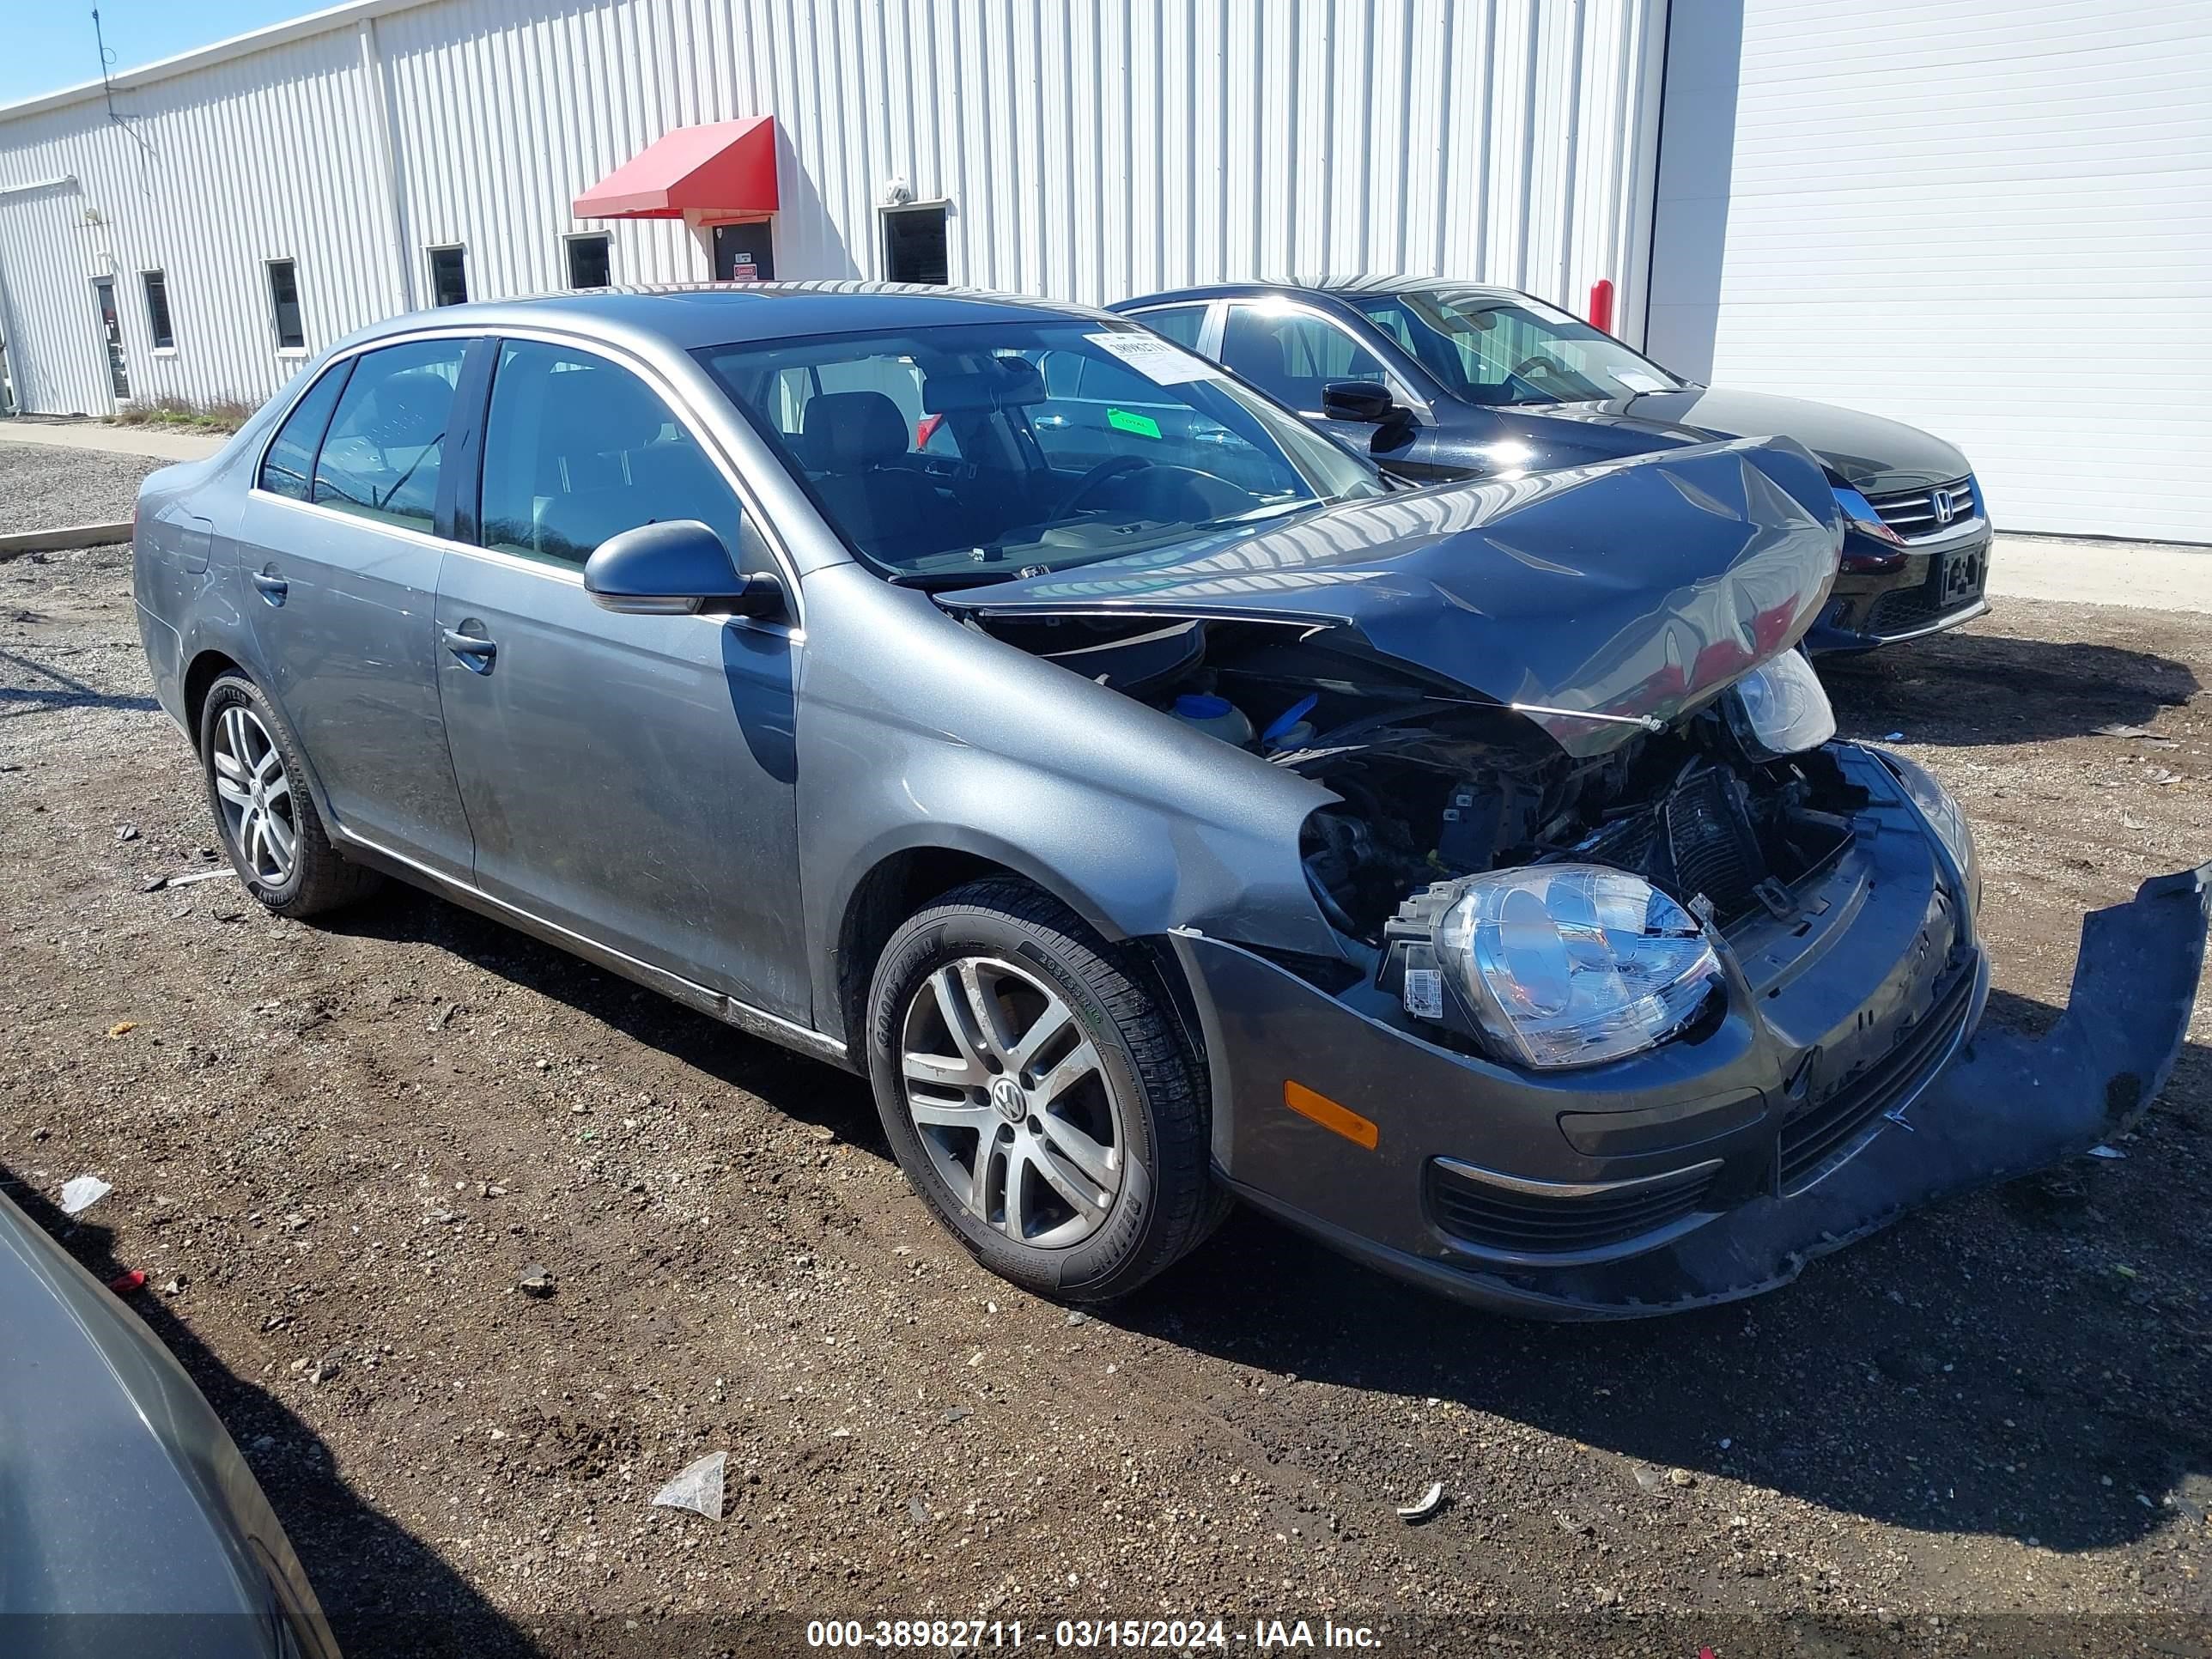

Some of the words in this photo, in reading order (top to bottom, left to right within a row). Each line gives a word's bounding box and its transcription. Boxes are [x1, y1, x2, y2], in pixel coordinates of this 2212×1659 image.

[1121, 417, 1146, 428] TOTAL
[877, 936, 936, 1048] GOODYEAR
[1037, 953, 1104, 1024] 205/55R16
[1087, 1192, 1142, 1274] RELIANT
